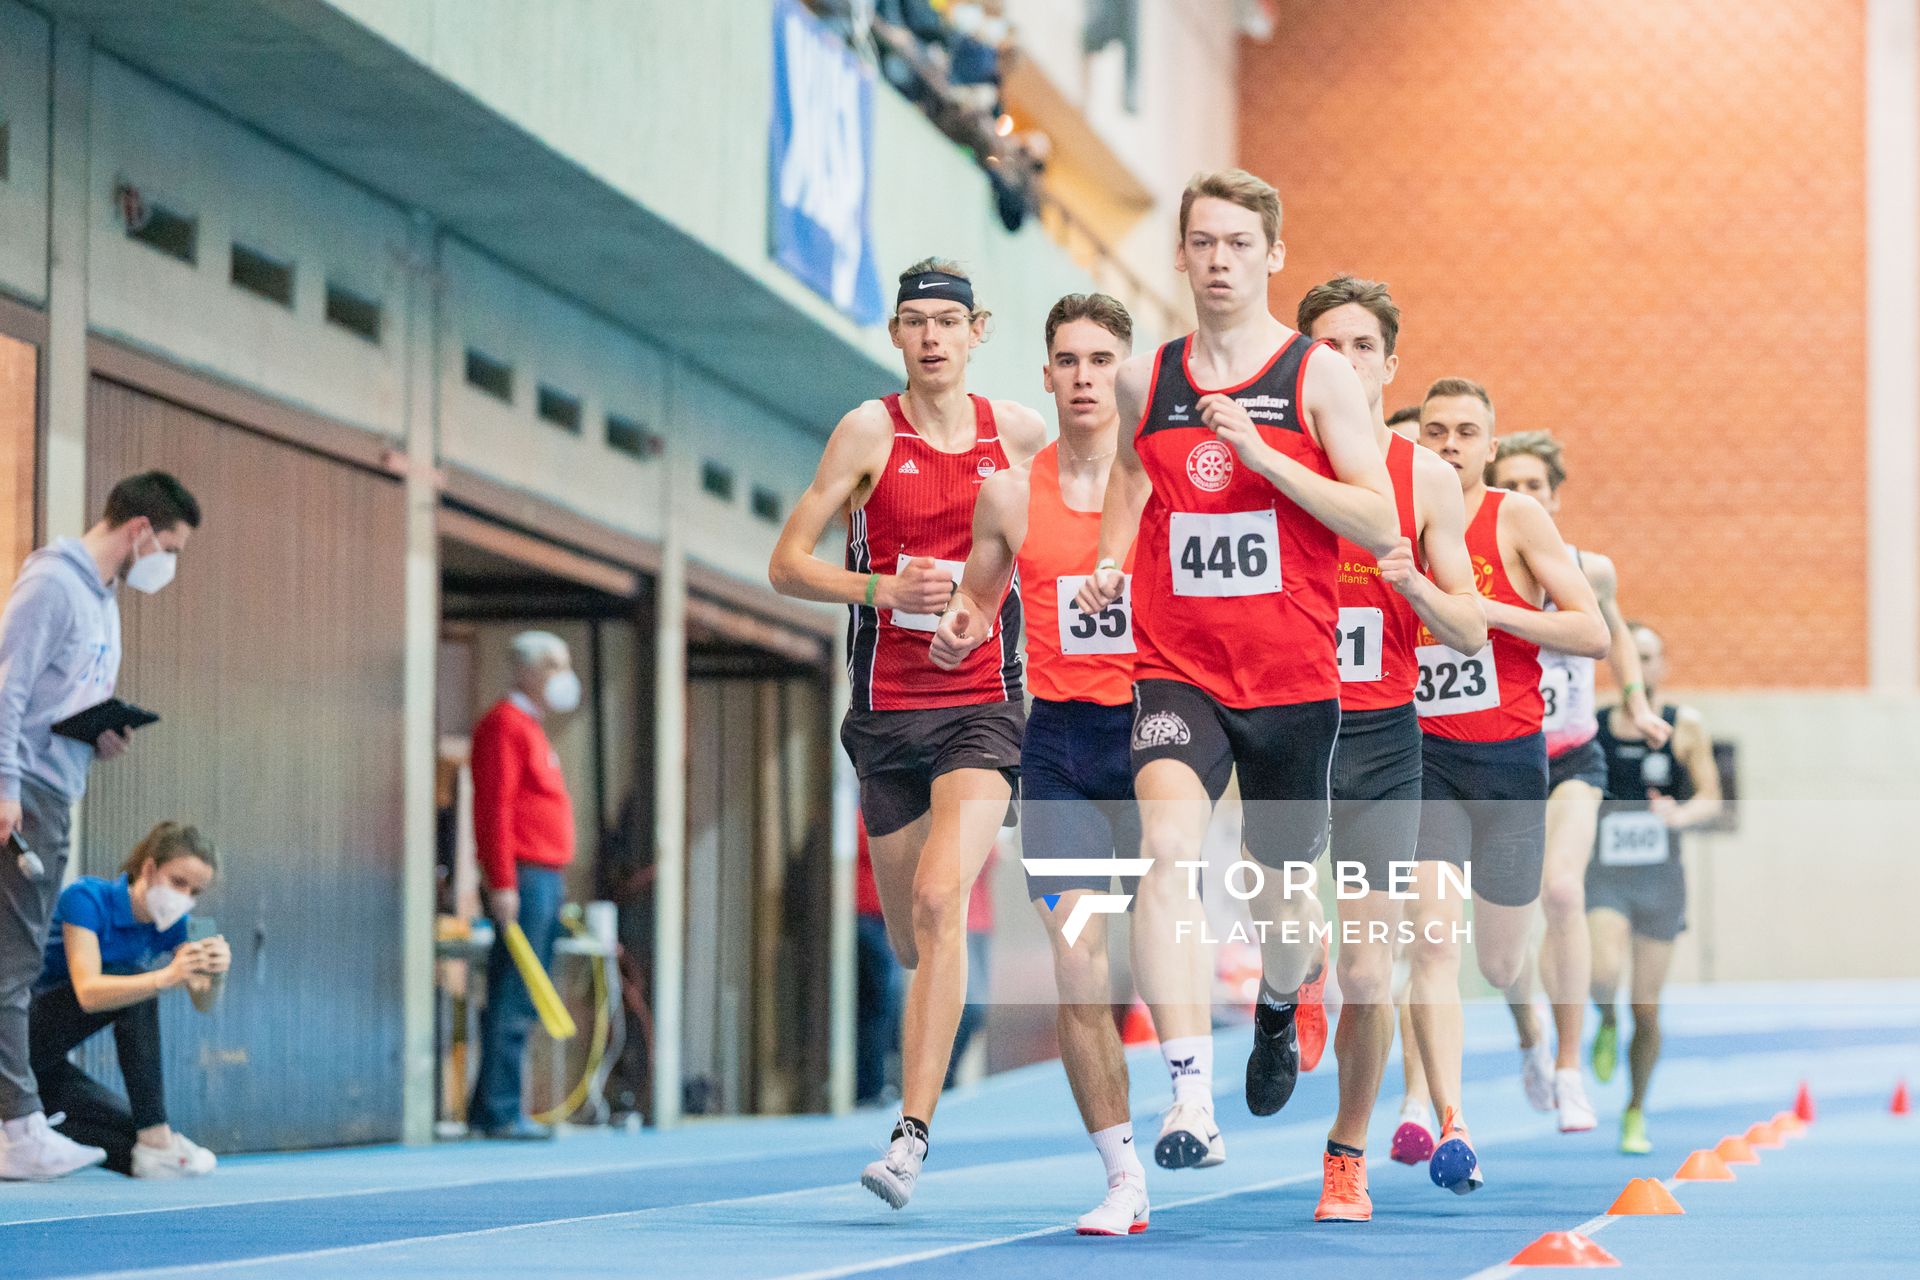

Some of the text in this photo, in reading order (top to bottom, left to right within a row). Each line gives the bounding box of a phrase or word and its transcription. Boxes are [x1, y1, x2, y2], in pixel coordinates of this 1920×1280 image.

[1181, 533, 1268, 578] 446
[1344, 562, 1351, 572] &
[1069, 597, 1132, 638] 35
[1415, 659, 1487, 702] 323
